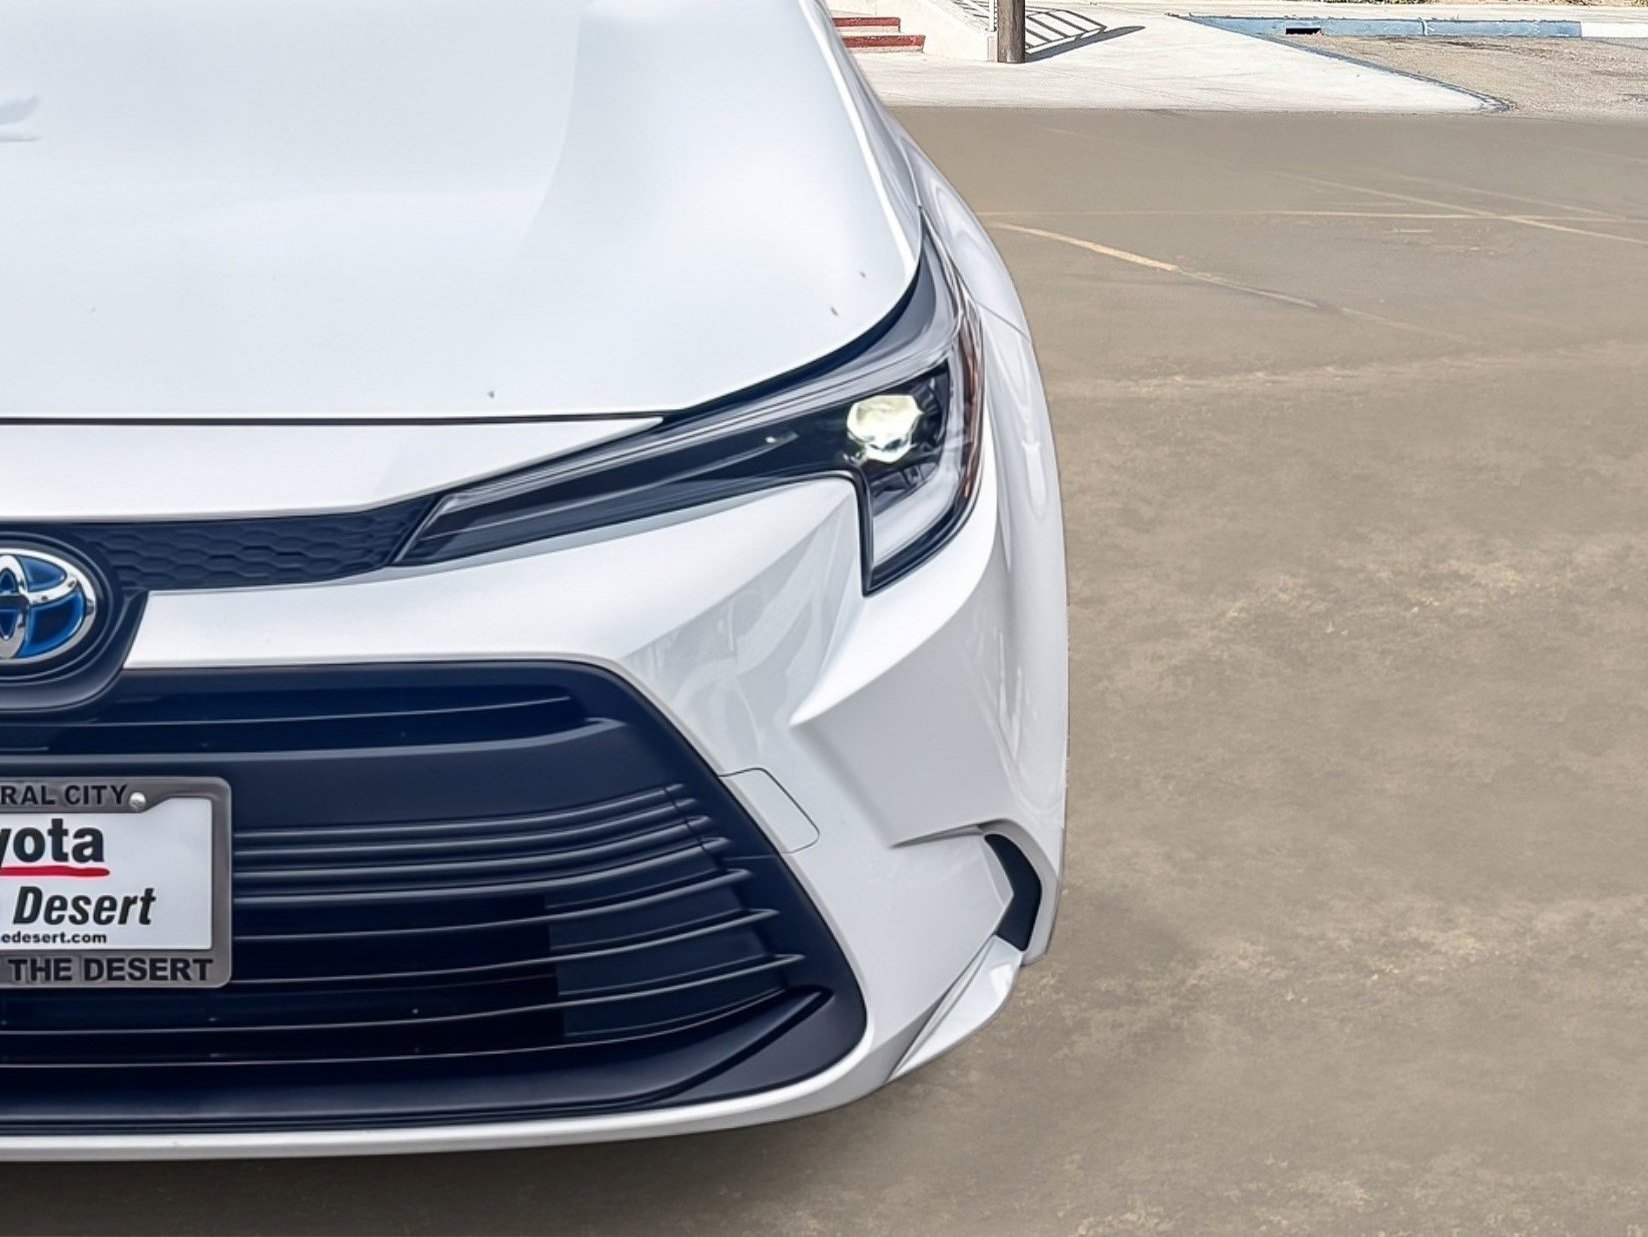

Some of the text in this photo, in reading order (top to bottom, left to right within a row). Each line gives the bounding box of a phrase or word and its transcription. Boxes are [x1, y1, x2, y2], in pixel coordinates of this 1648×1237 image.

[64, 784, 128, 805] CITY
[12, 886, 156, 925] Desert
[8, 959, 73, 981] THE
[83, 958, 213, 981] DESERT
